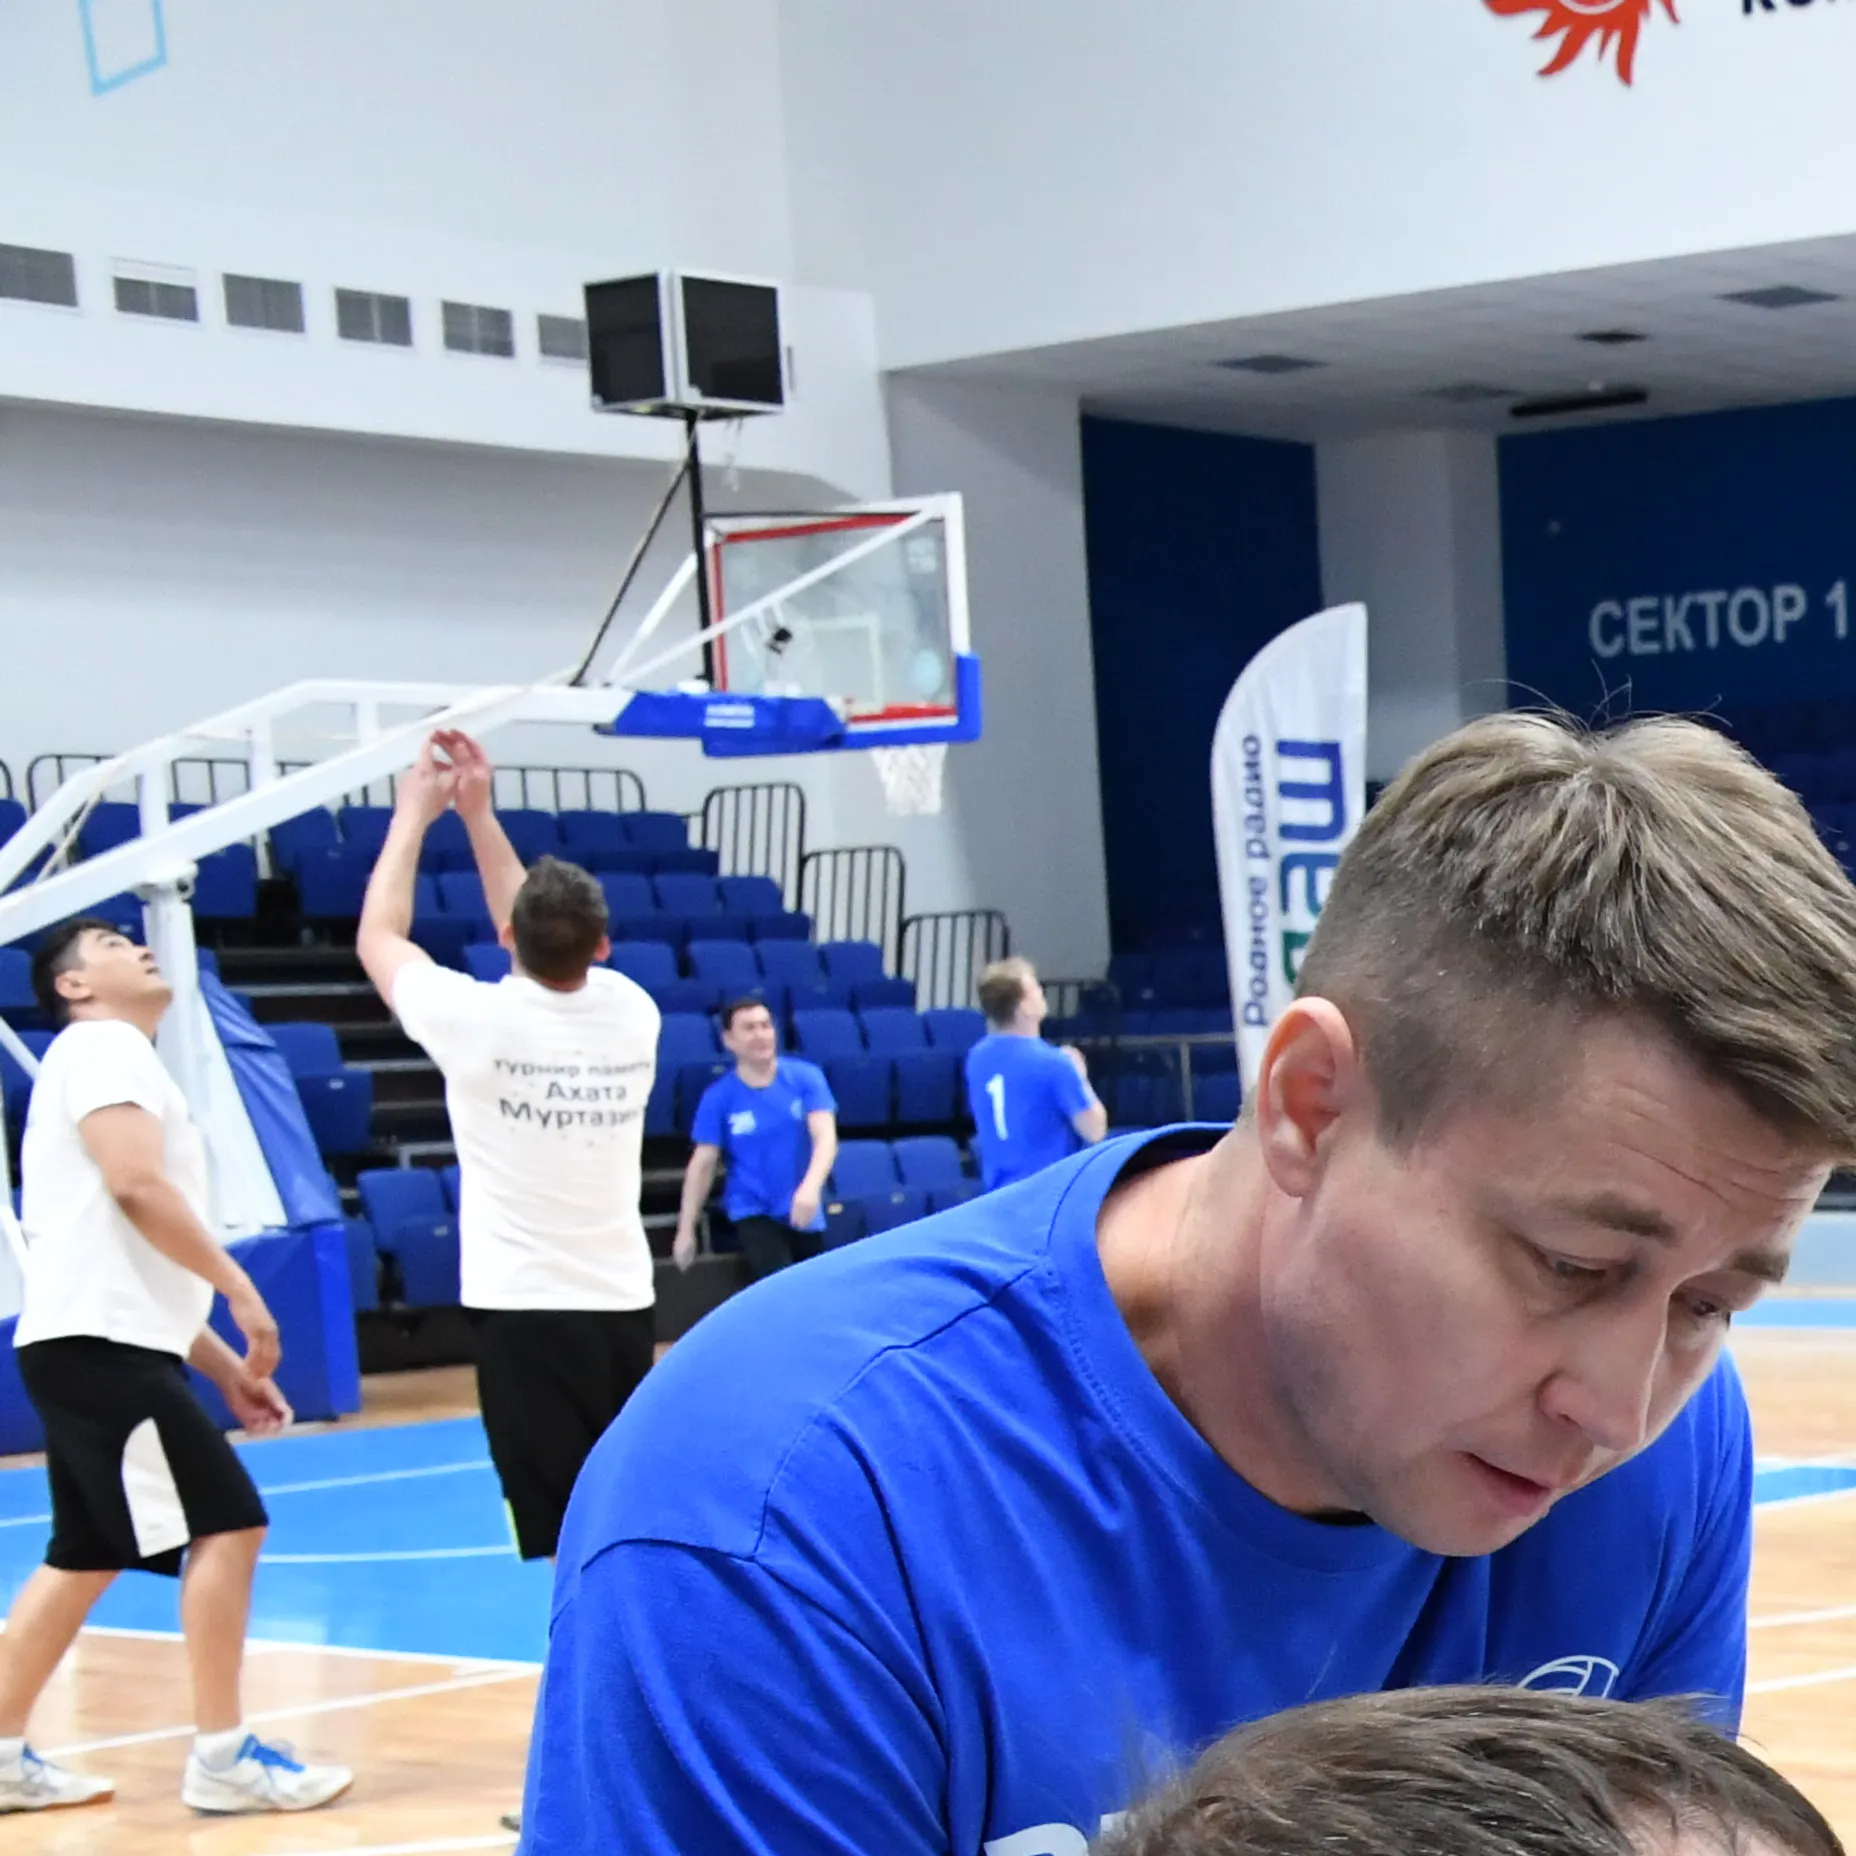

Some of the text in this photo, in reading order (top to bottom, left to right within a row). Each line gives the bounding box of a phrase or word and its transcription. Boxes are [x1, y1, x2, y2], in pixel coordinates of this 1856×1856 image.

[1590, 580, 1849, 658] СЕКТОР 1
[1242, 734, 1270, 1026] Родное радио
[493, 1059, 581, 1078] турнир
[545, 1081, 628, 1102] Ахата
